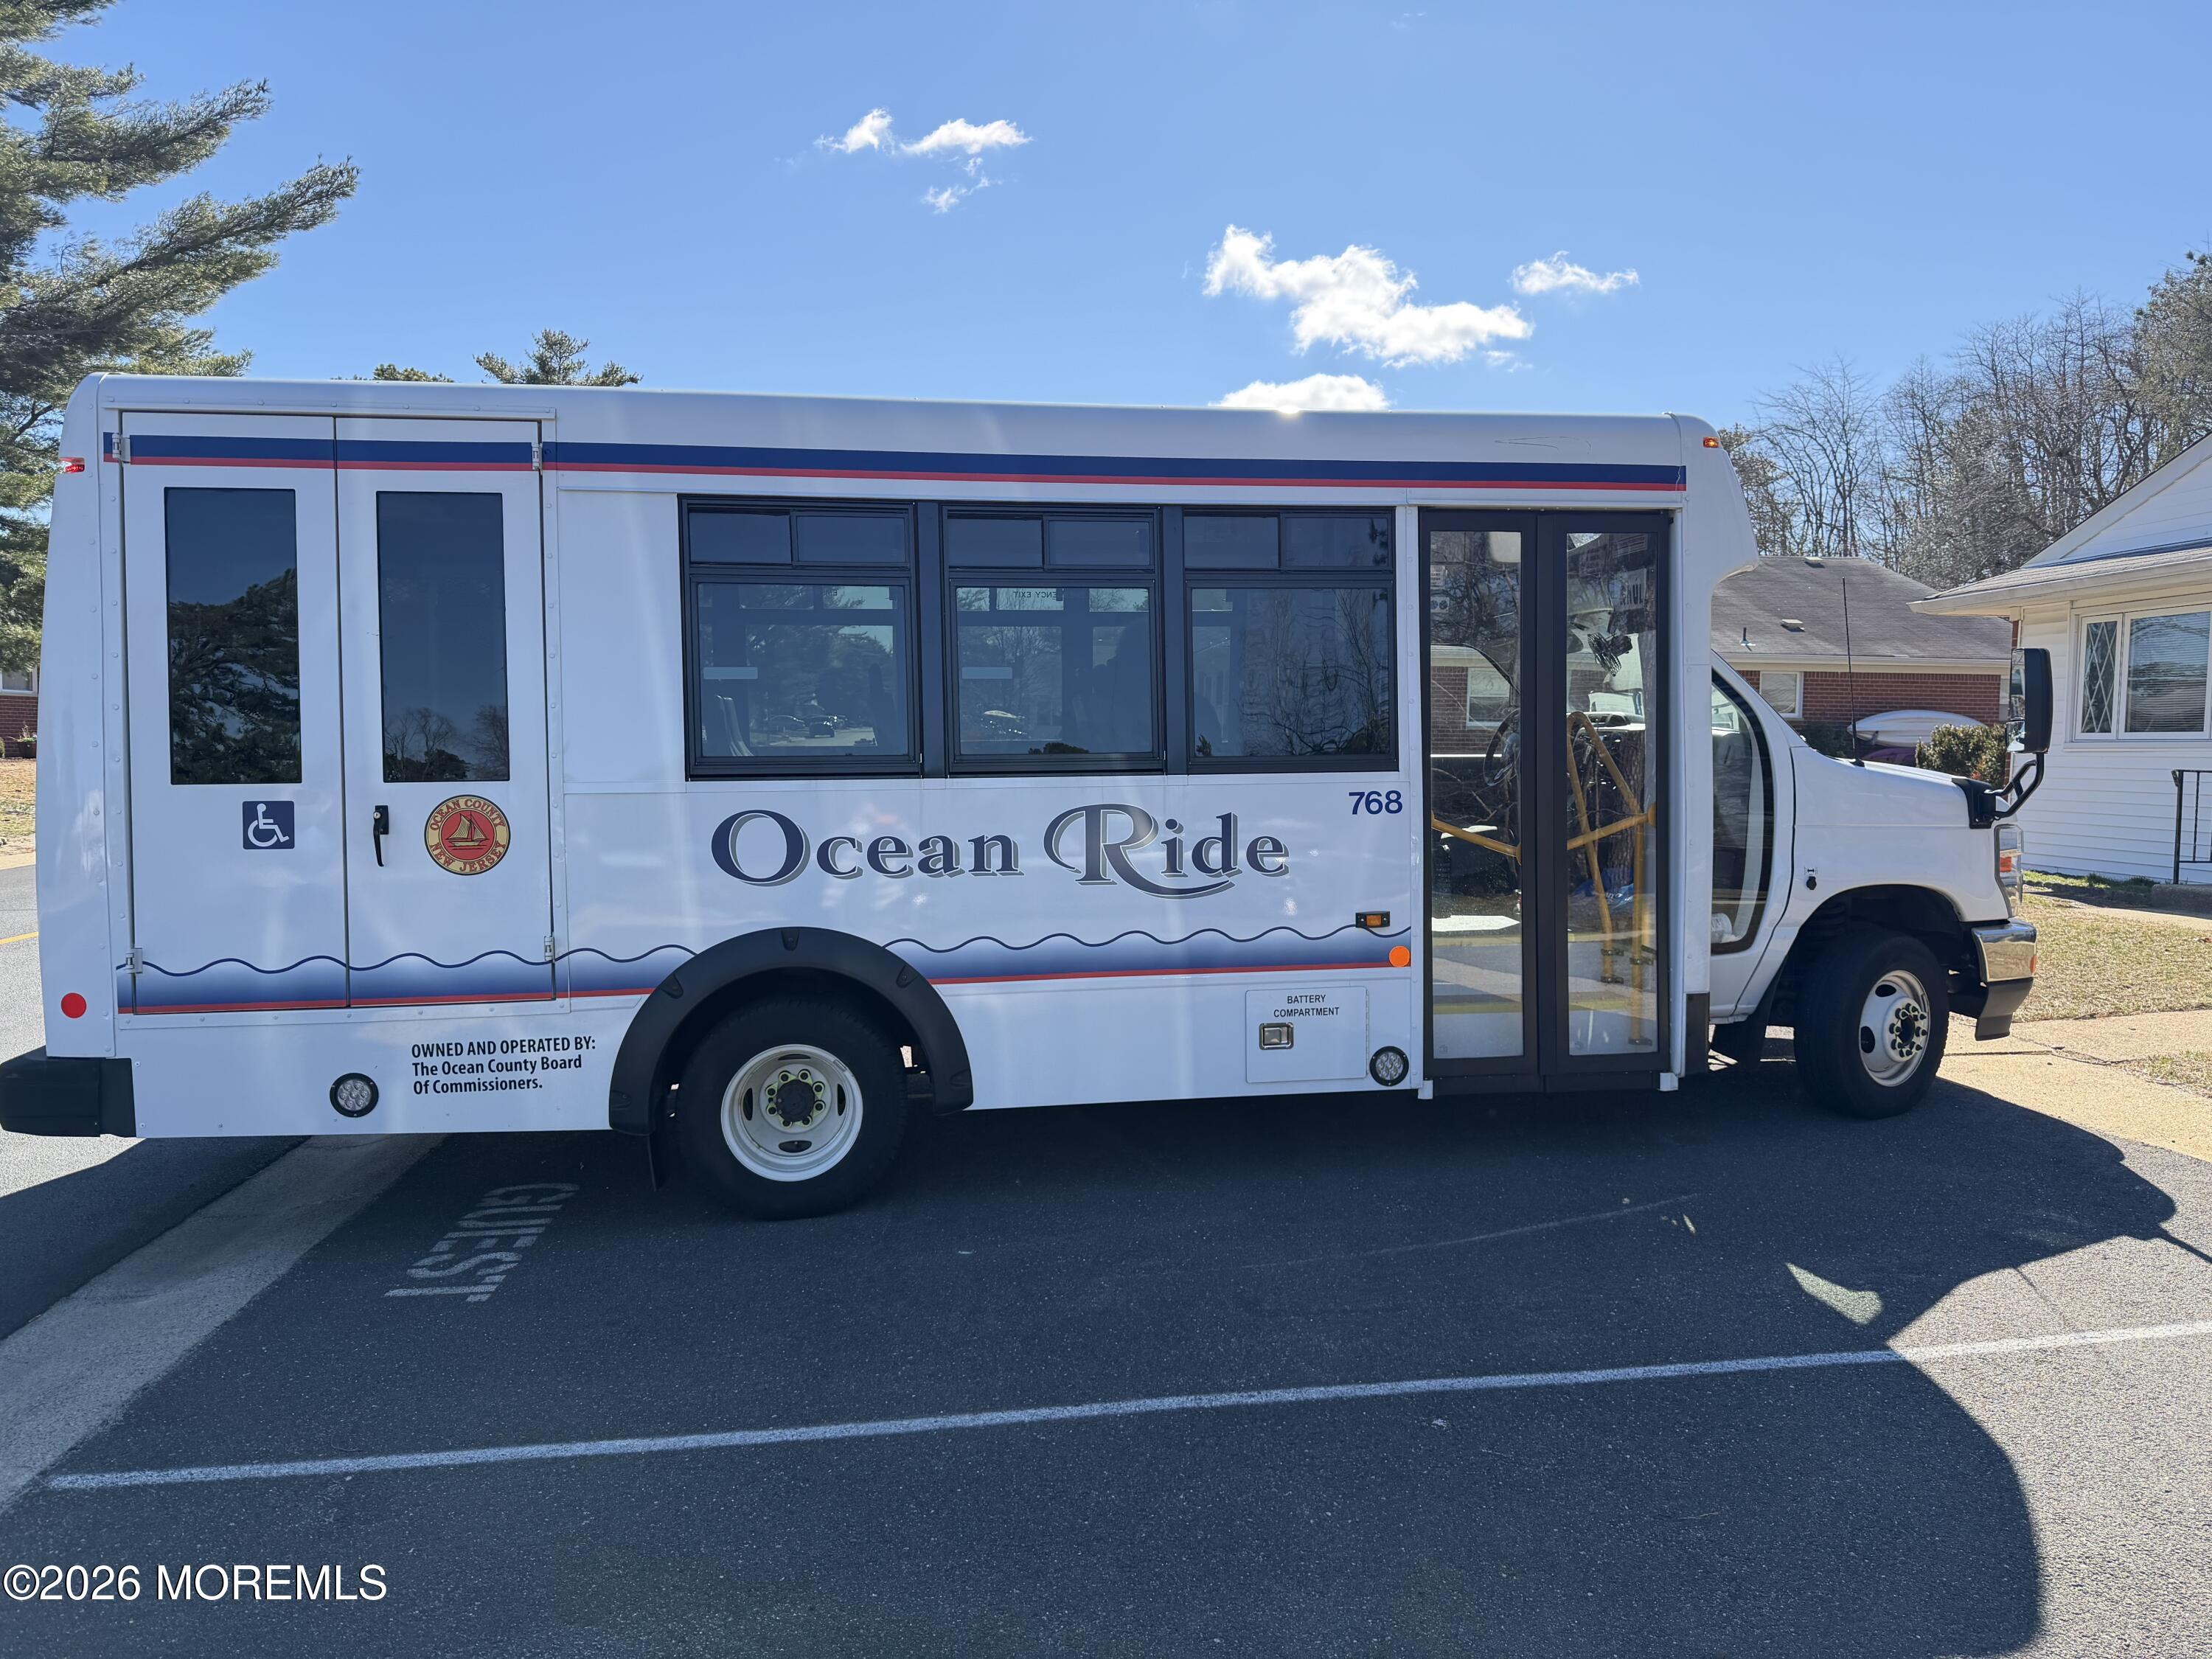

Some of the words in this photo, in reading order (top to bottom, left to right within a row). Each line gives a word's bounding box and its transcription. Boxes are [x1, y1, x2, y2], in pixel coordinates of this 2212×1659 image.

[430, 799, 462, 830] OCEAN
[464, 799, 505, 827] COUNTY
[1348, 790, 1403, 815] 768
[430, 842, 455, 866] NEW
[459, 840, 506, 872] JERSEY
[711, 809, 1025, 887] Ocean
[1043, 804, 1290, 900] Ride
[1287, 994, 1326, 1004] BATTERY
[1273, 1006, 1340, 1018] COMPARTMENT
[411, 1043, 464, 1058] OWNED
[467, 1040, 496, 1056] AND
[500, 1037, 571, 1054] OPERATED
[574, 1036, 596, 1050] BY:
[412, 1062, 438, 1077] The
[442, 1060, 484, 1075] Ocean
[487, 1059, 537, 1074] County
[540, 1054, 582, 1070] Board
[413, 1079, 429, 1094] Of
[433, 1077, 543, 1093] Commissioners.
[383, 1183, 580, 1302] GUEST
